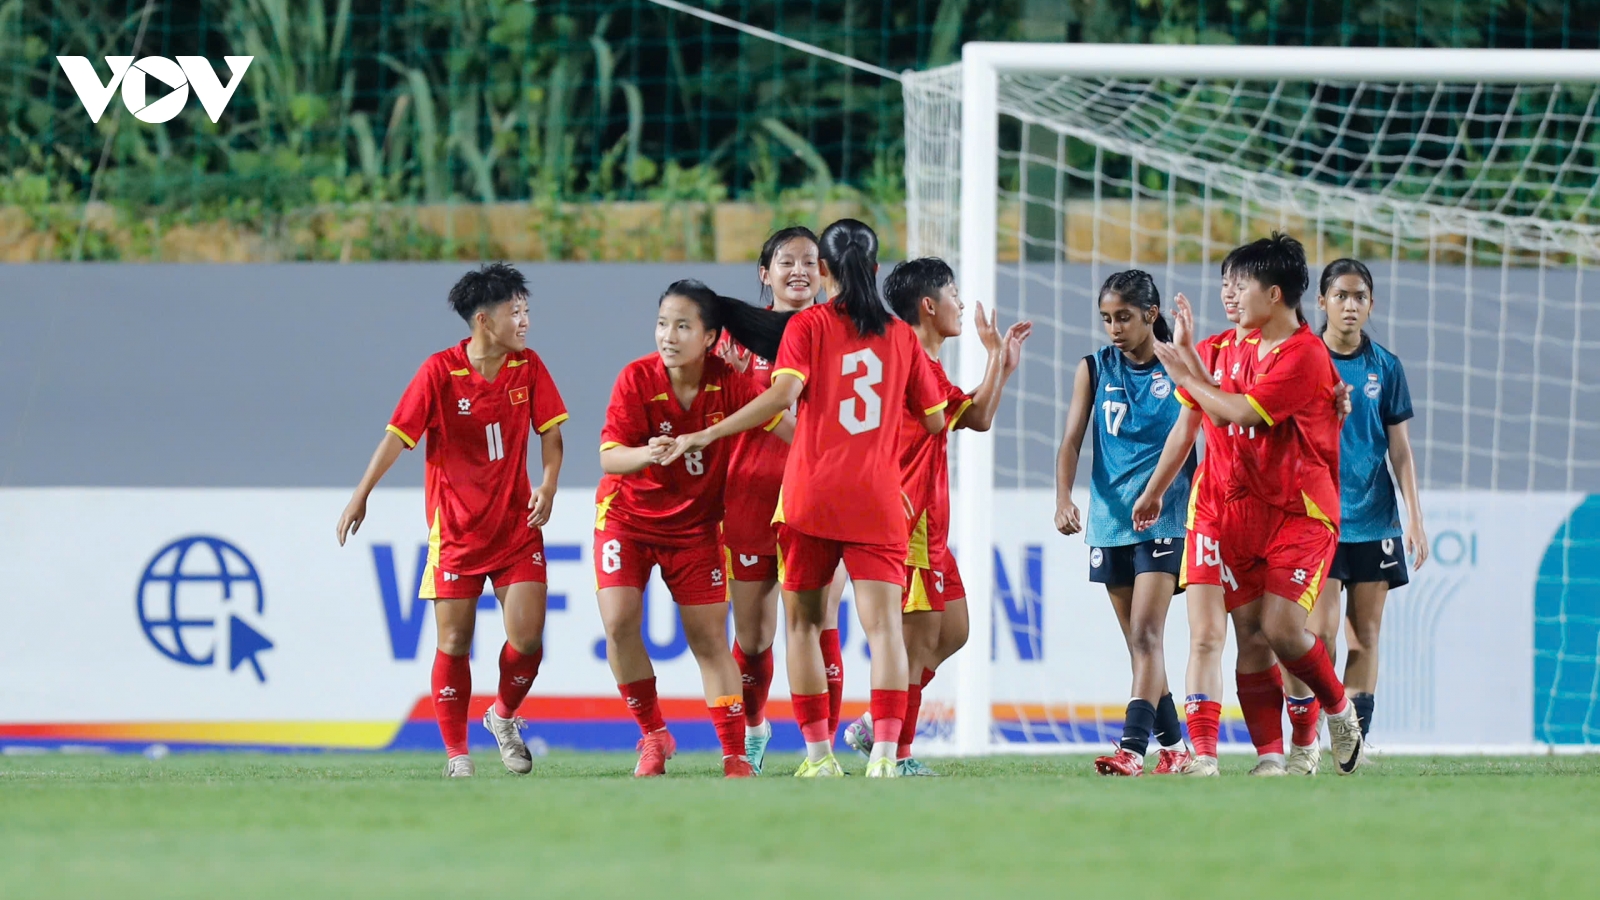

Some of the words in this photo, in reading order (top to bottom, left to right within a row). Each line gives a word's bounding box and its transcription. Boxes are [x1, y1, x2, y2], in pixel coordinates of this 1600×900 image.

[839, 348, 883, 435] 3
[1102, 400, 1127, 436] 17
[485, 421, 504, 462] 11
[684, 450, 704, 476] 8
[602, 539, 621, 574] 8
[1195, 532, 1220, 567] 19
[1219, 558, 1239, 594] 4
